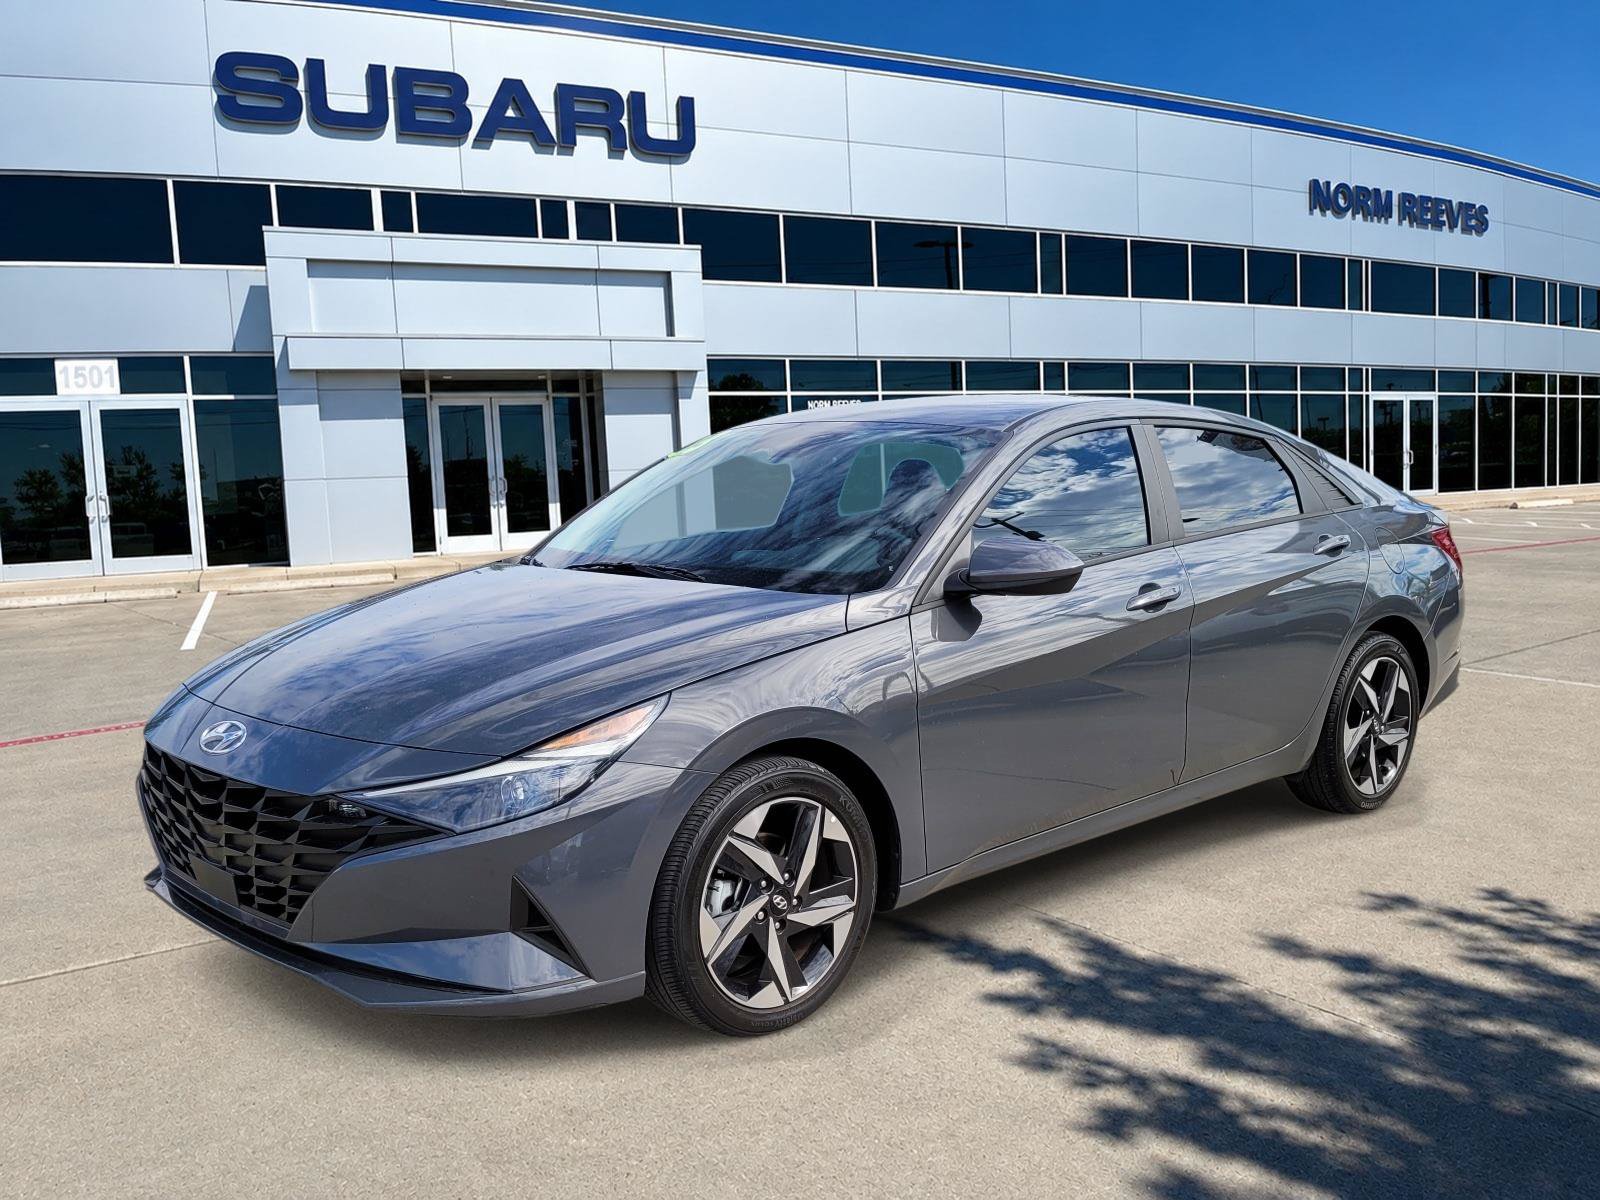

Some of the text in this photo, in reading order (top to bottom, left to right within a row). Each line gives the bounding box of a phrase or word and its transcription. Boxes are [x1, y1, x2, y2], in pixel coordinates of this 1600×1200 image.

[214, 51, 696, 157] SUBARU
[1309, 178, 1489, 235] NORM REEVES
[58, 365, 115, 389] 1501
